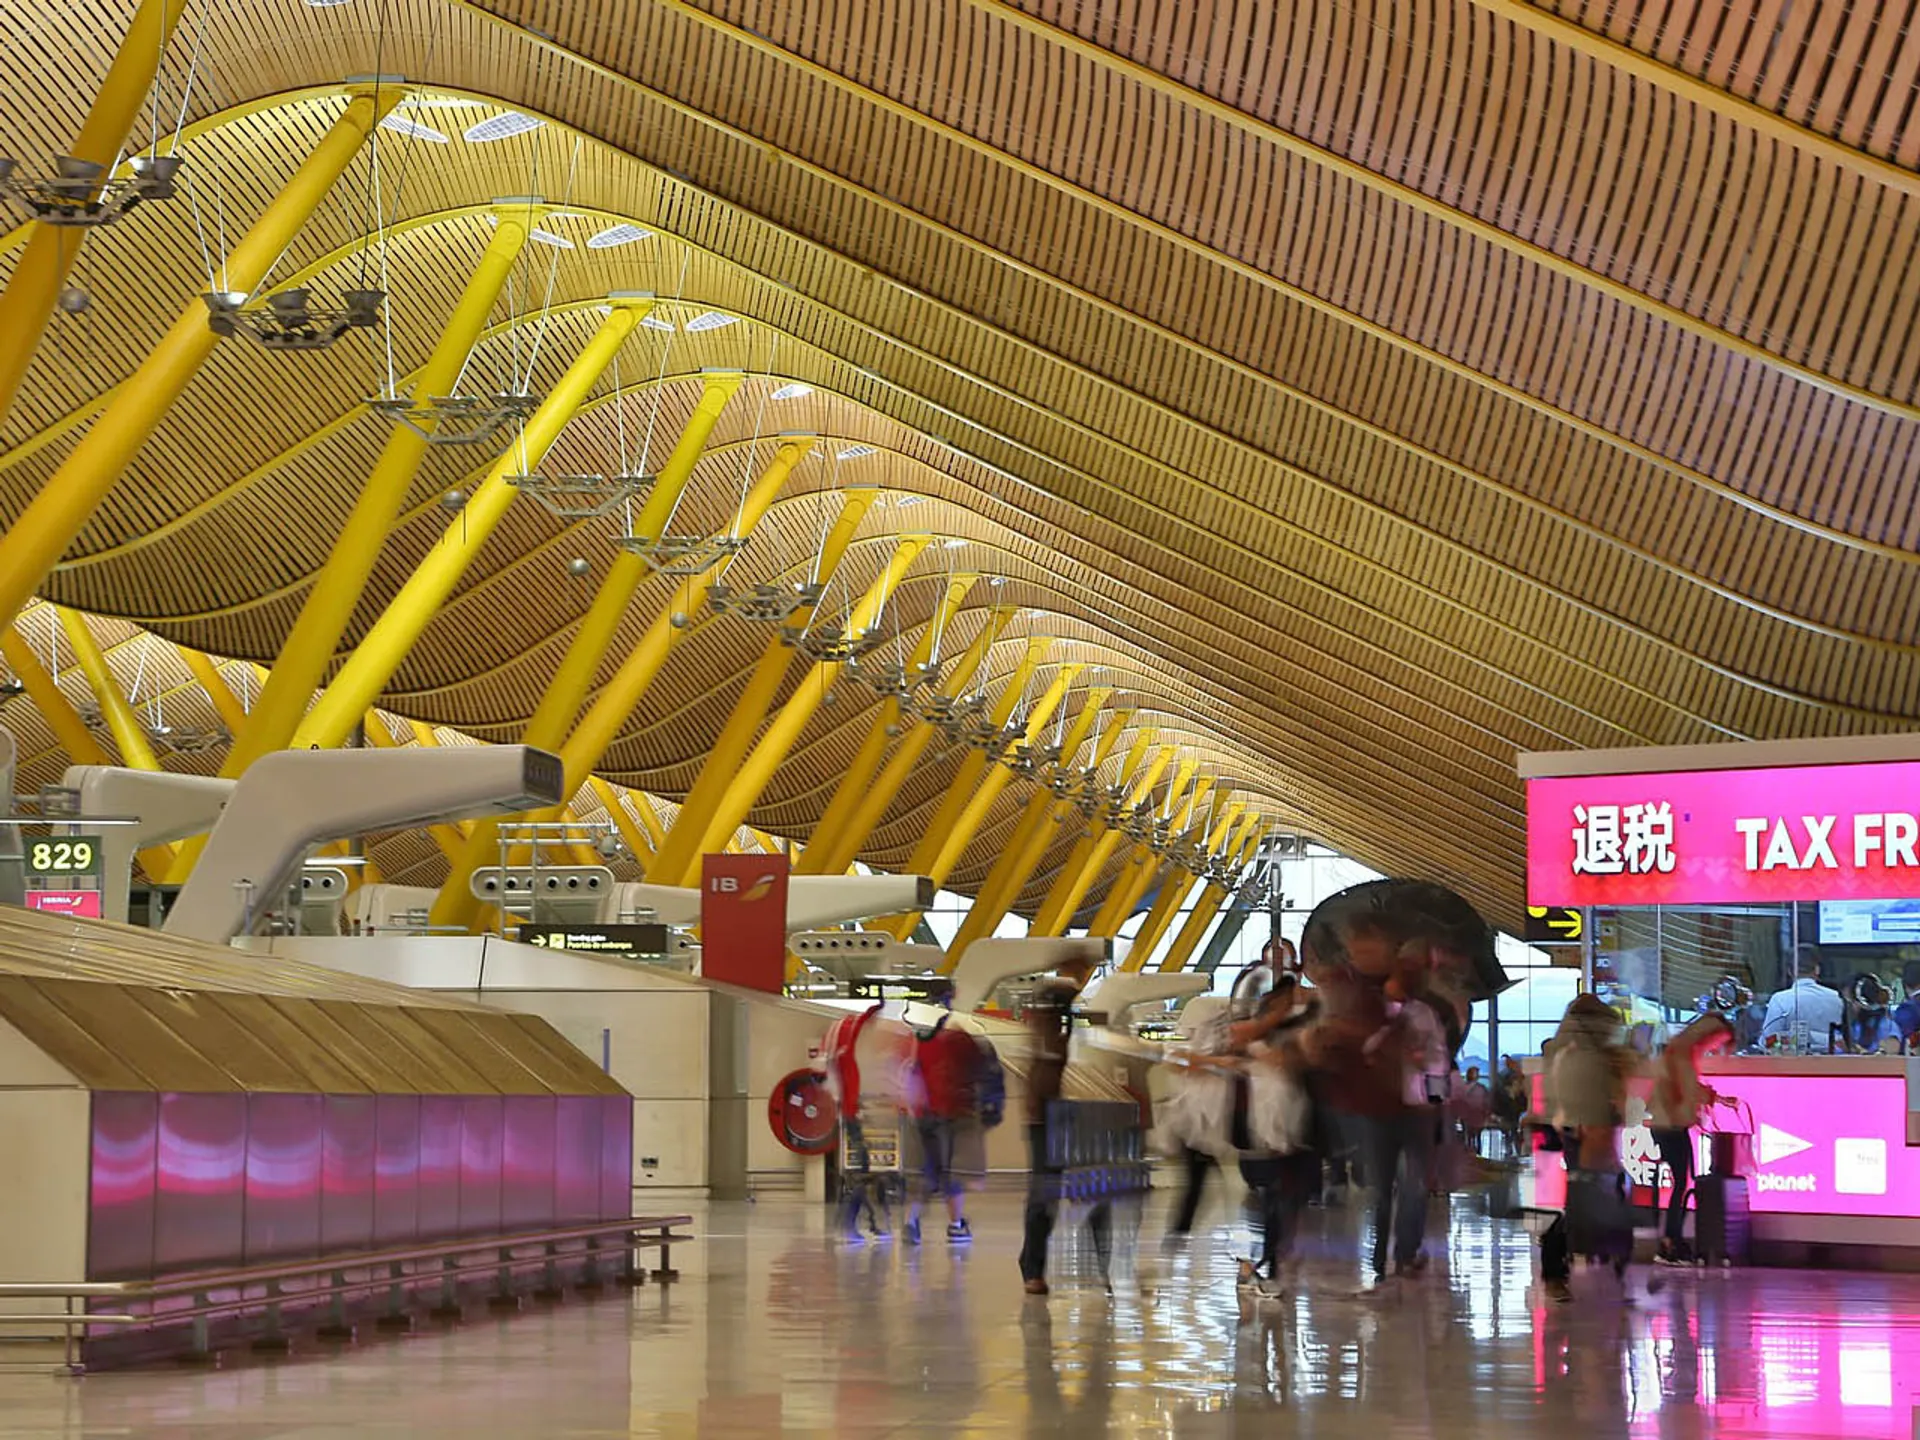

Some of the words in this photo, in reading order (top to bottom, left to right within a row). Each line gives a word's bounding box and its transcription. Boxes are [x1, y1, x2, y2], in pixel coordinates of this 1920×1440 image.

[1572, 801, 1676, 875] 退税
[1735, 815, 1839, 871] TAX
[1853, 813, 1920, 868] FR
[32, 842, 92, 870] 829
[711, 877, 739, 892] IB
[1757, 1172, 1817, 1192] planet
